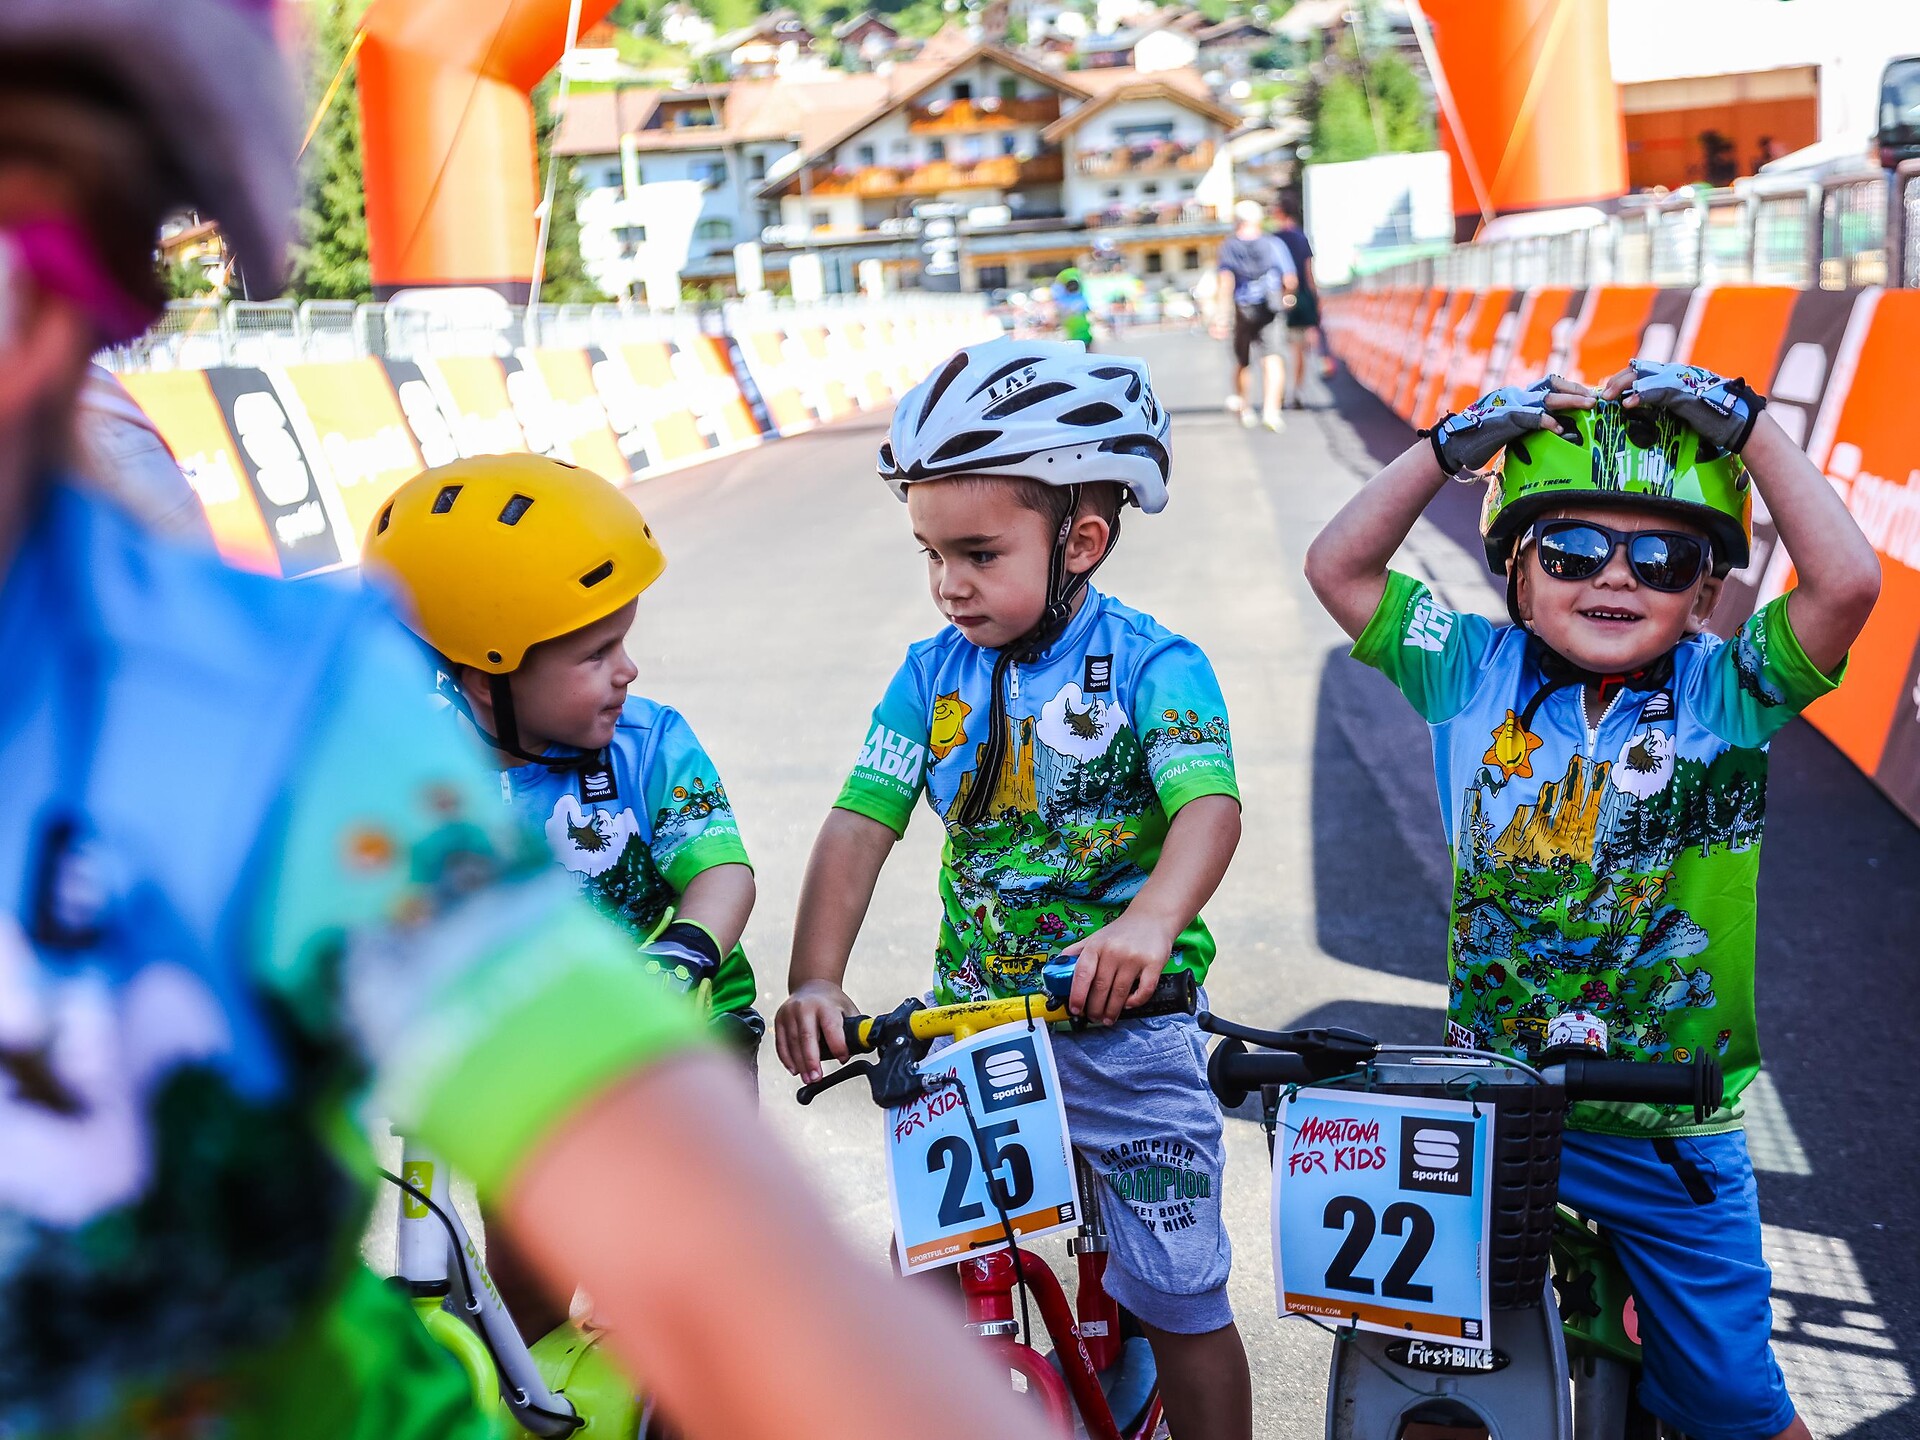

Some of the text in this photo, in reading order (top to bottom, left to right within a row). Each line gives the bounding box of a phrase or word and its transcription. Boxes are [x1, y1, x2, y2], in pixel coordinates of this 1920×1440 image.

[986, 366, 1037, 401] LAS
[866, 724, 925, 760] ALTA
[852, 769, 889, 787] olomites
[855, 744, 925, 789] BADIA
[1155, 763, 1189, 793] RATONA
[1189, 759, 1213, 770] FOR
[586, 788, 612, 798] sportful
[703, 825, 726, 838] FOR
[992, 1082, 1033, 1101] sportful
[894, 1111, 925, 1144] FOR
[1293, 1116, 1380, 1150] MARATONA
[1100, 1139, 1196, 1167] CHAMPION
[1156, 1153, 1183, 1168] NINE
[1288, 1145, 1387, 1178] FOR KIDS
[926, 1118, 1034, 1229] 25
[1103, 1165, 1211, 1204] AMPION
[1412, 1169, 1459, 1183] sportful
[1133, 1201, 1190, 1218] EET BOYS
[1162, 1211, 1197, 1233] NINE
[910, 1244, 961, 1265] SPORTFUL.COM
[1322, 1194, 1436, 1304] 22
[1287, 1301, 1342, 1317] SPORTFUL.COM
[1407, 1340, 1494, 1370] FirstBIKE
